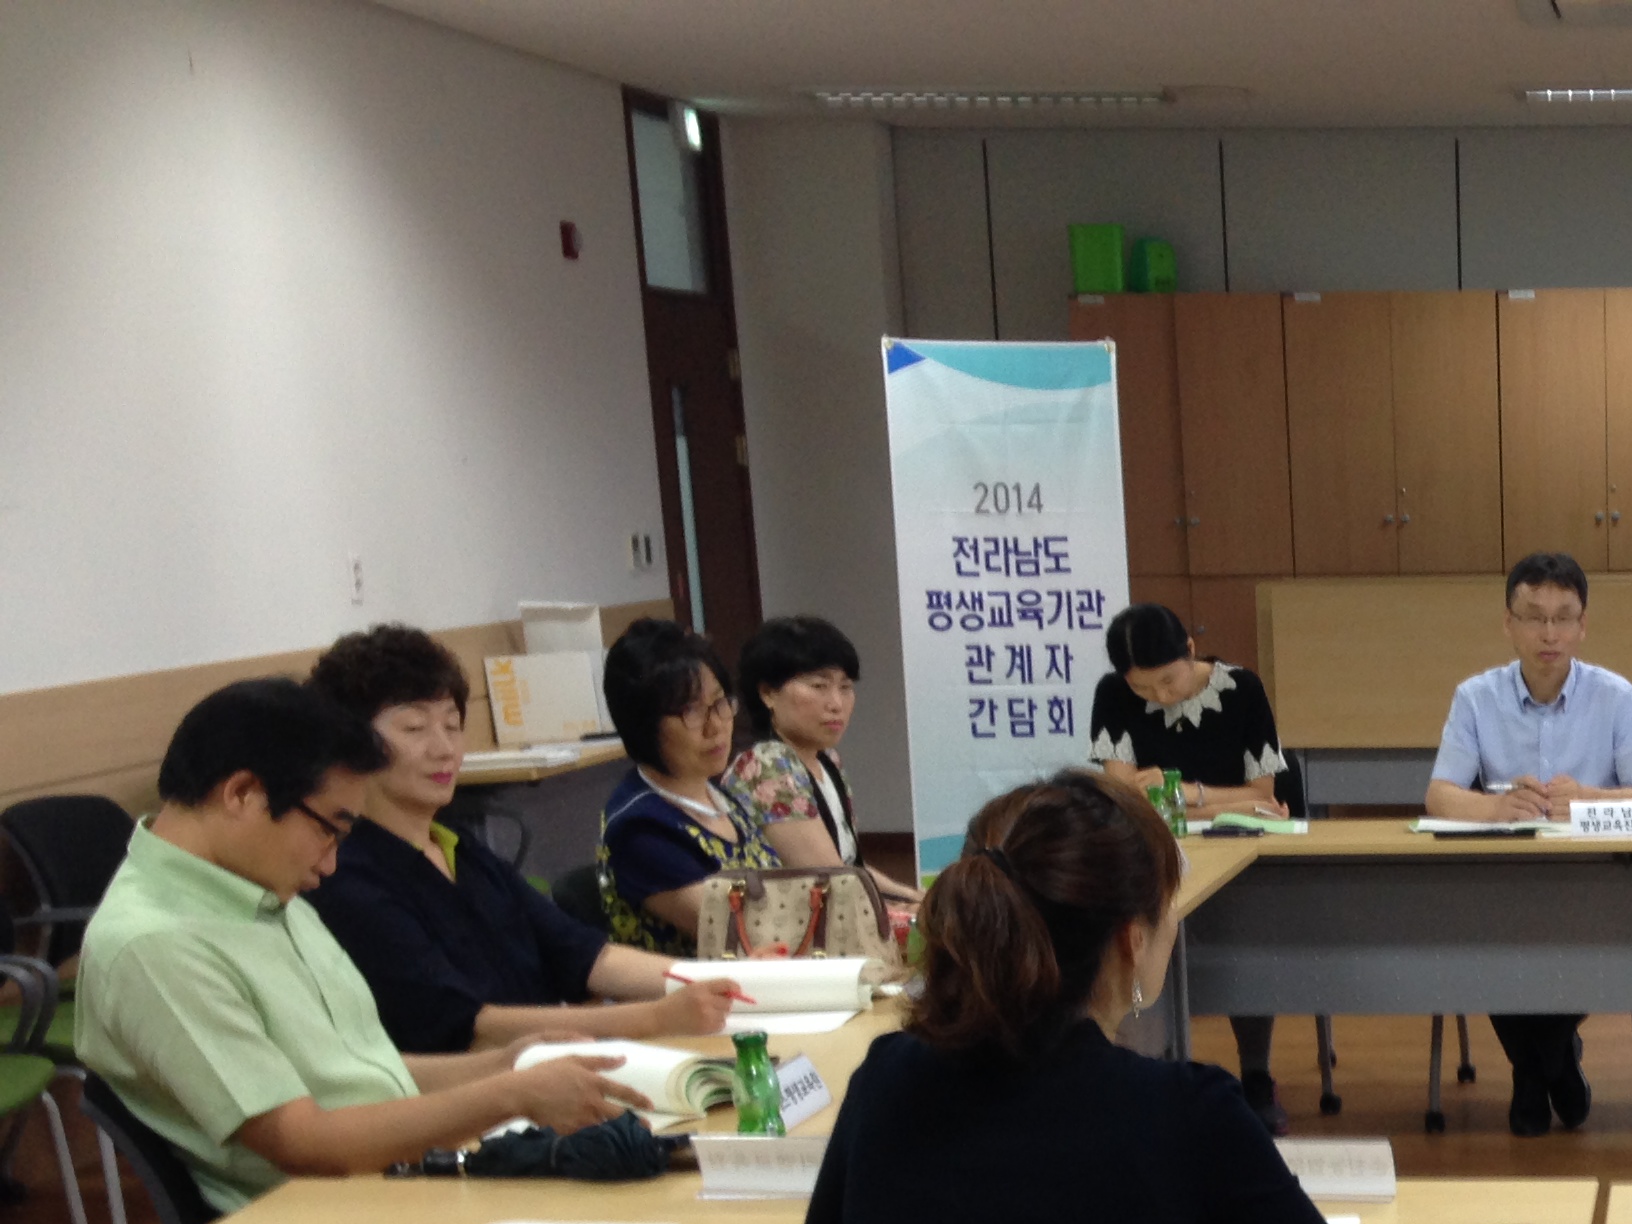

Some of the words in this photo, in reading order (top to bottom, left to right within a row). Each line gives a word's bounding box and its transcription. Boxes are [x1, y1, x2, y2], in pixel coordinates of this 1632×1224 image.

[973, 481, 1044, 516] 2014
[951, 535, 1072, 578] 전라남도
[925, 589, 1106, 633] 평생교육기관
